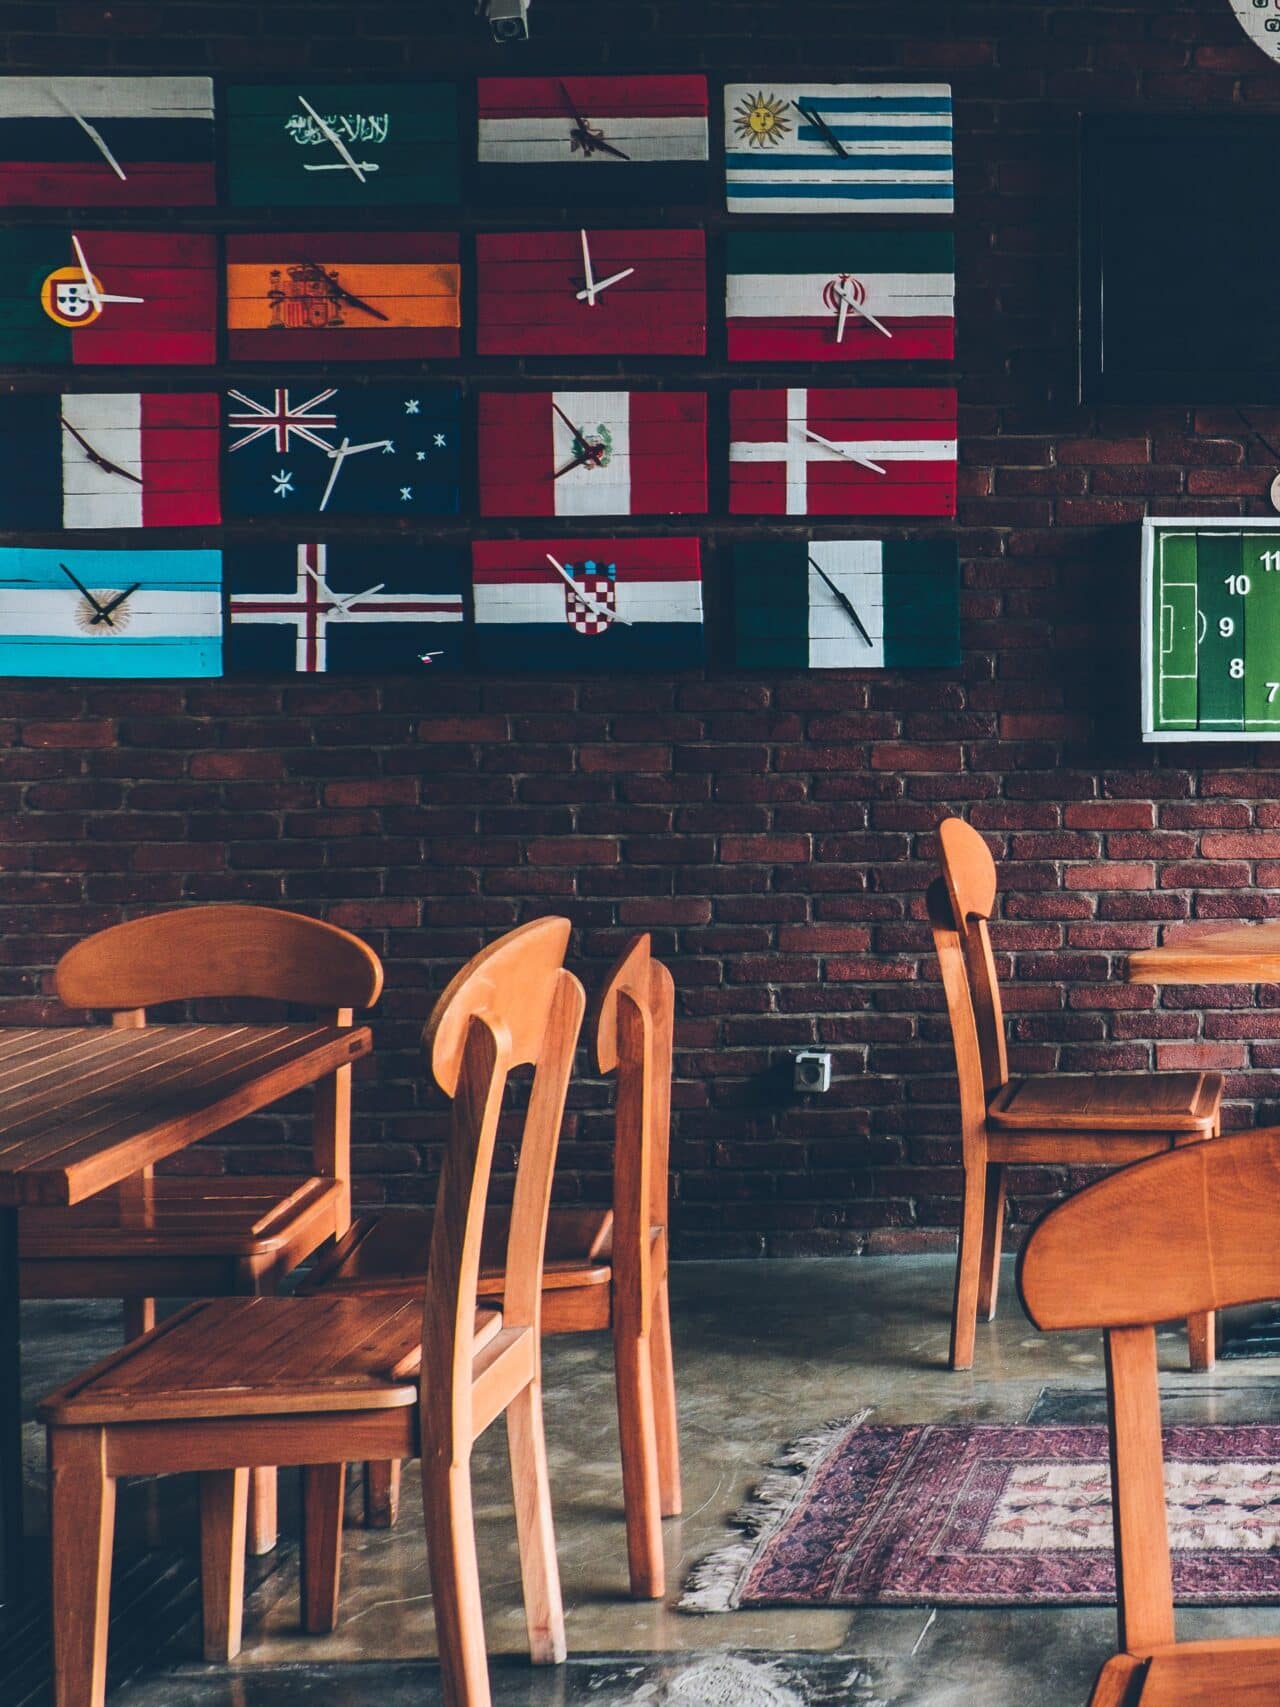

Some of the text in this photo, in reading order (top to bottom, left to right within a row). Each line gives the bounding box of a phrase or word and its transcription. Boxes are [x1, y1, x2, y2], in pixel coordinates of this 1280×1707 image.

[1260, 551, 1280, 571] 11
[1224, 574, 1250, 595] 10
[1219, 617, 1234, 637] 9
[1229, 658, 1244, 679] 8
[1265, 682, 1280, 703] 7
